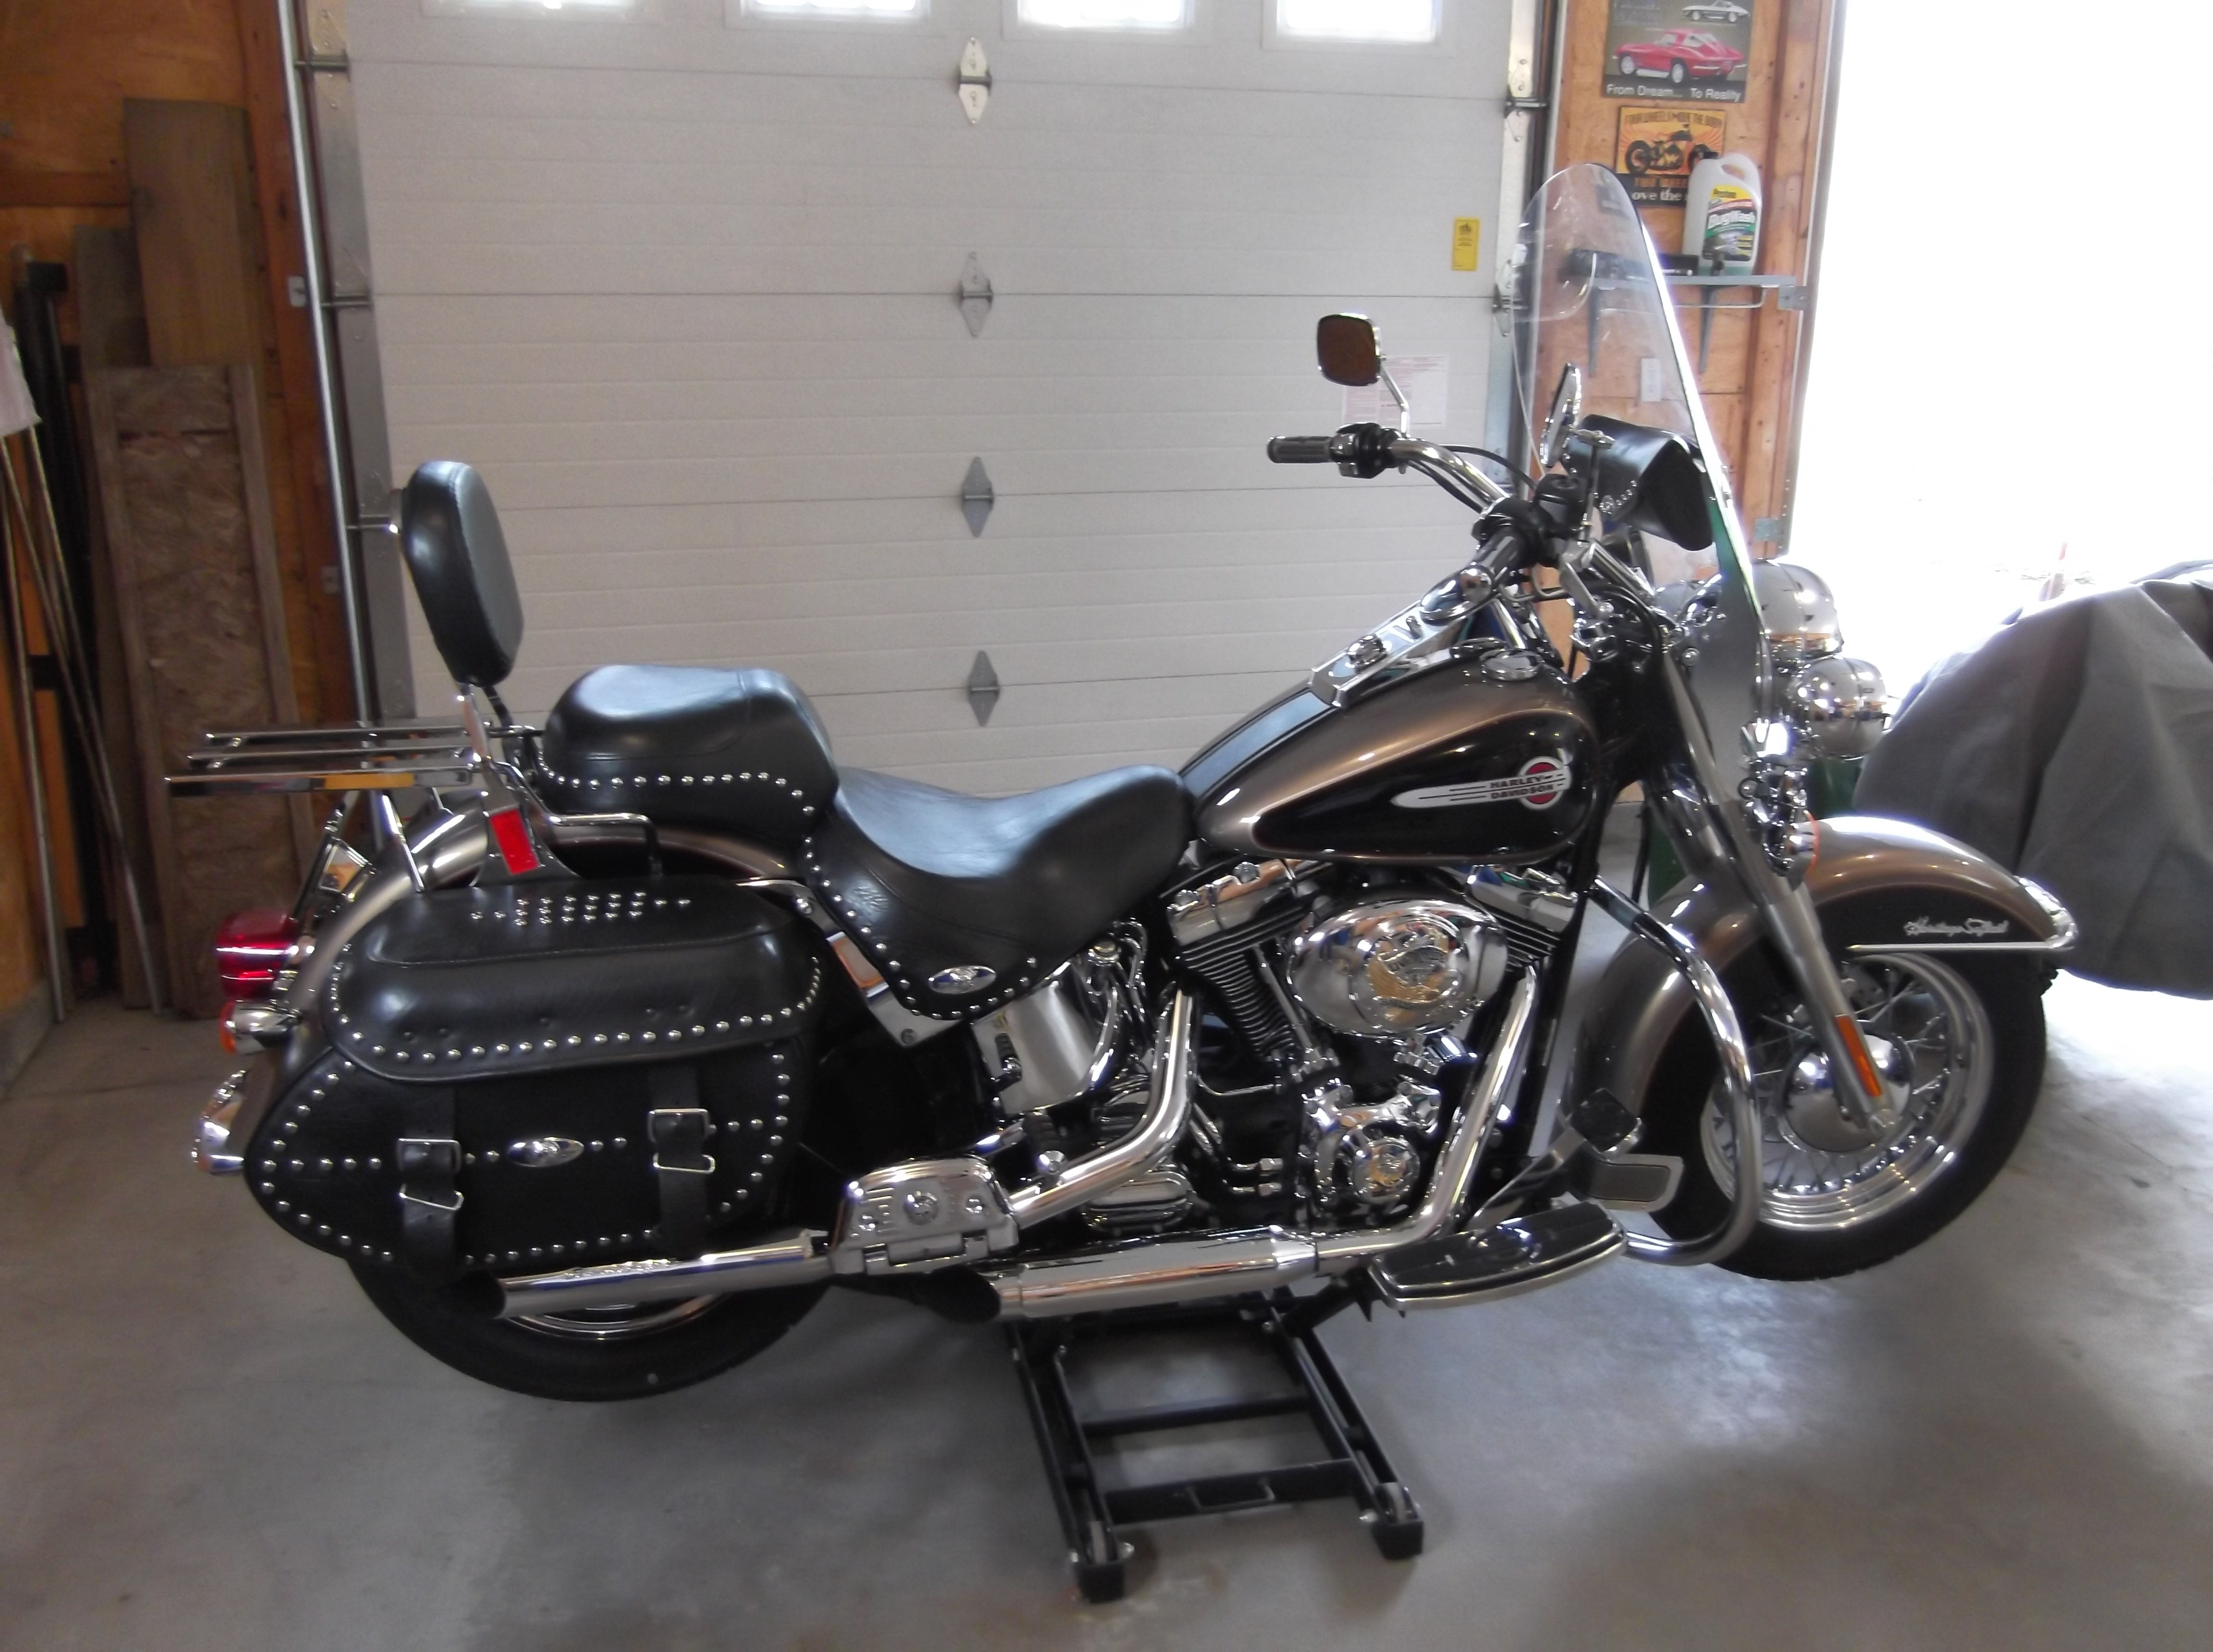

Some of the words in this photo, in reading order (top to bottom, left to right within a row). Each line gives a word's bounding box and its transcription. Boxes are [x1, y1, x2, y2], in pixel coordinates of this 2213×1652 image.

[1606, 84, 1634, 95] From
[1690, 87, 1703, 98] To
[1705, 88, 1741, 103] Reality
[1631, 192, 1657, 201] ove
[1660, 188, 1682, 201] the
[1491, 784, 1554, 800] DAVIDSON
